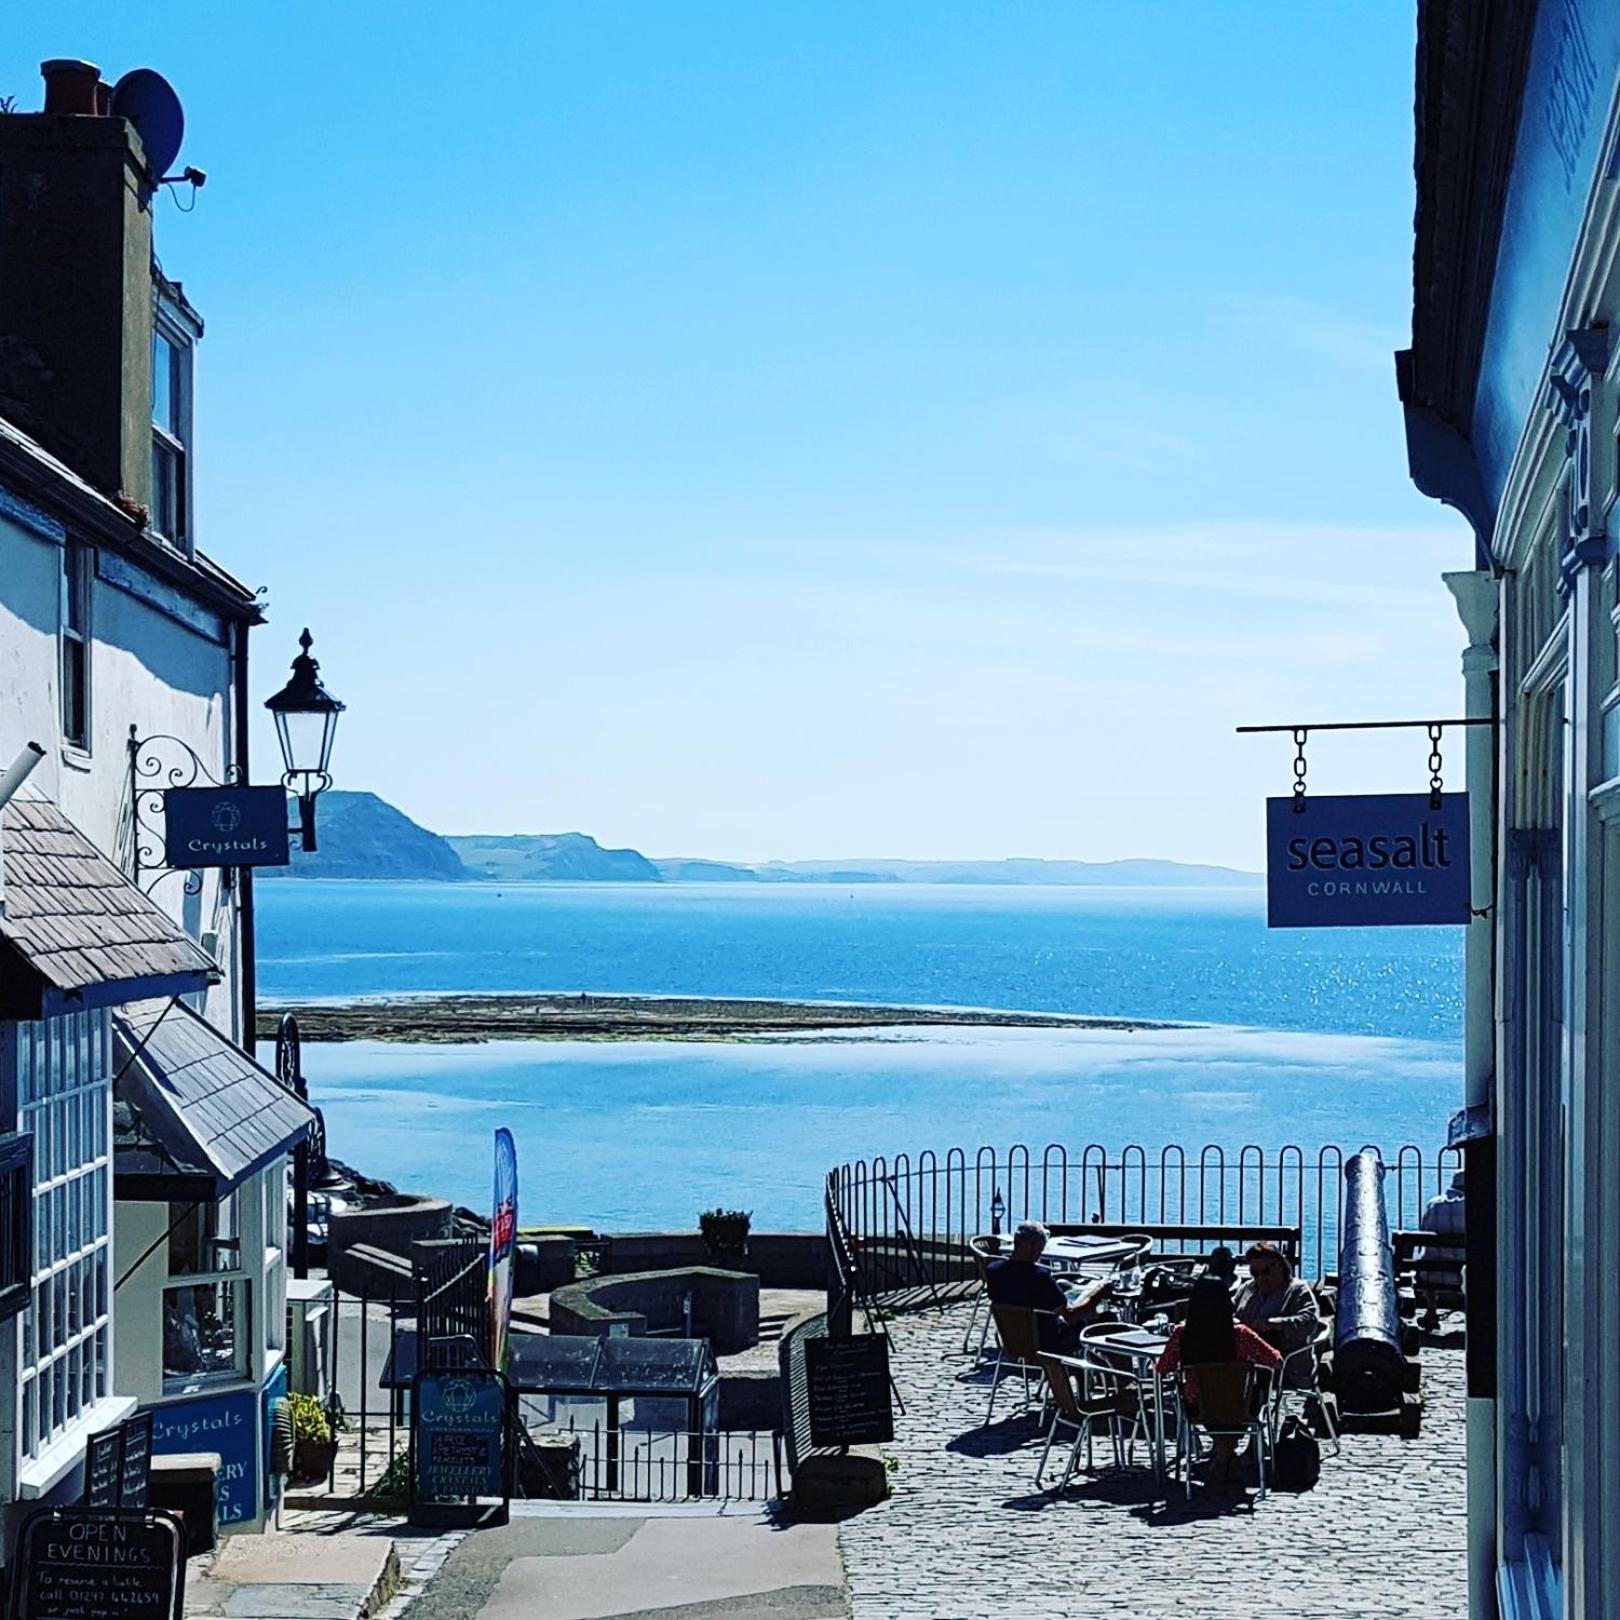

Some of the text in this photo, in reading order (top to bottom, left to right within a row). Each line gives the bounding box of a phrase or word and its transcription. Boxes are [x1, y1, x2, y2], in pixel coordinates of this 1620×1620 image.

[188, 837, 268, 855] Crystals
[1287, 822, 1451, 871] seasalt
[1307, 881, 1427, 896] CORNWALL
[152, 1410, 242, 1440] Crystals
[421, 1409, 497, 1426] Crystals
[69, 1523, 127, 1543] OPEN
[47, 1543, 151, 1564] EVENINGS
[37, 1571, 52, 1585] To
